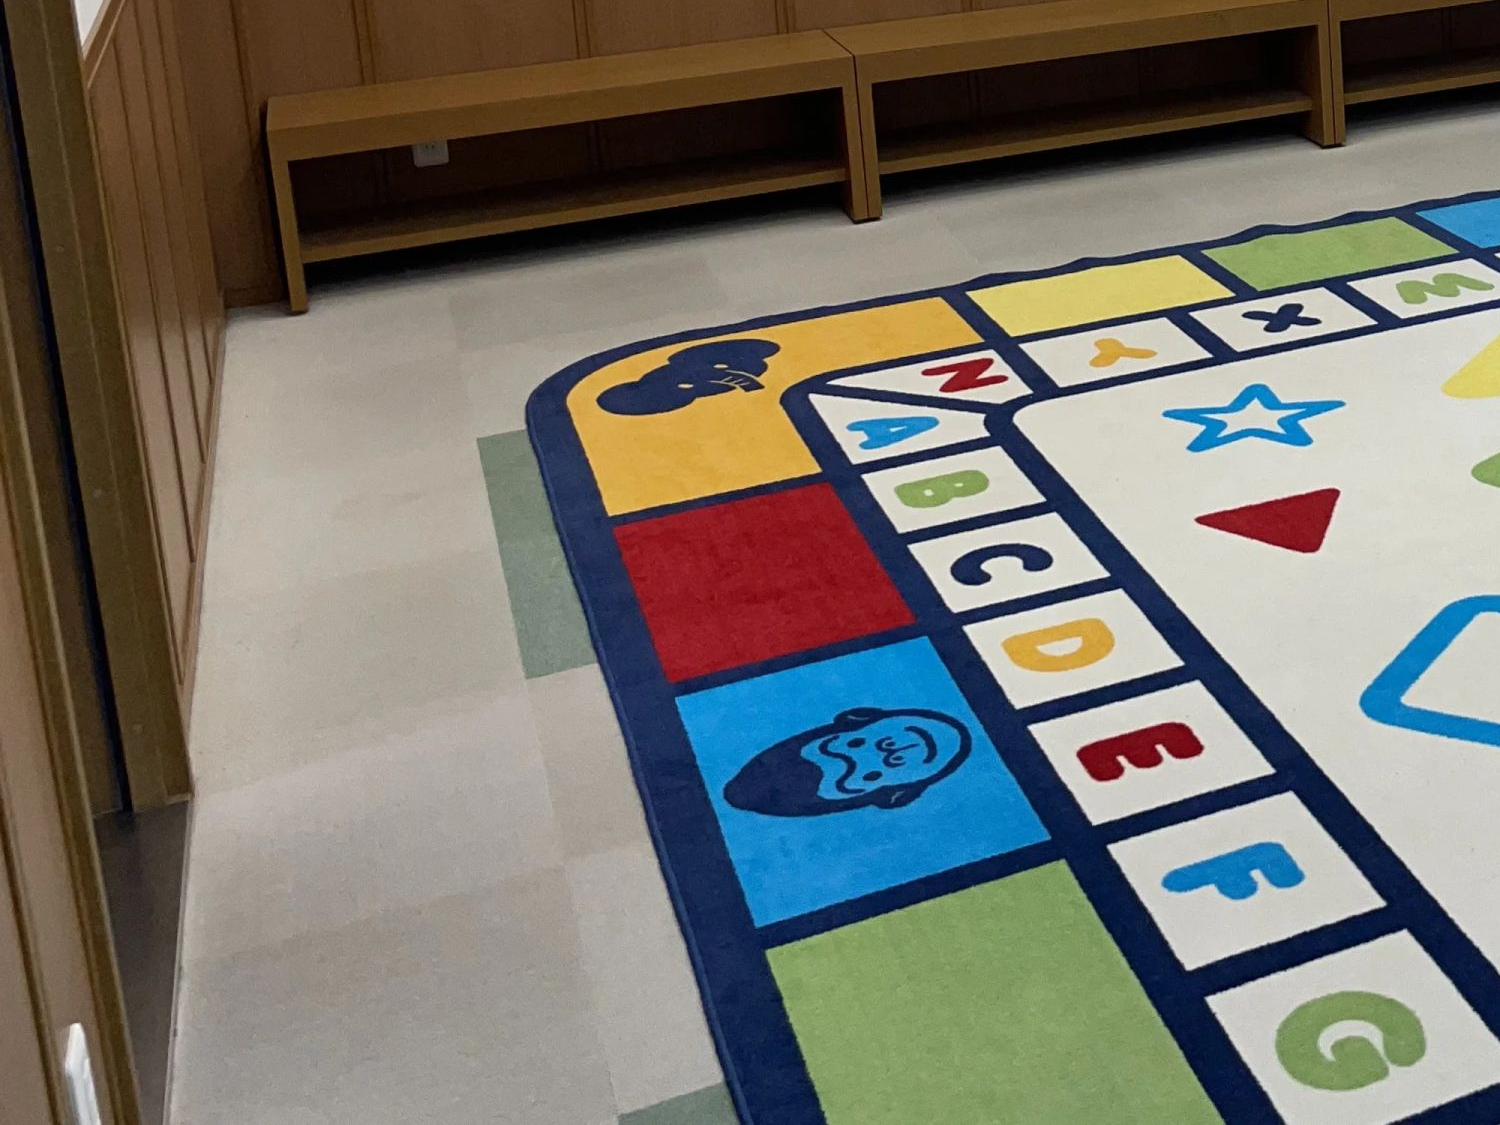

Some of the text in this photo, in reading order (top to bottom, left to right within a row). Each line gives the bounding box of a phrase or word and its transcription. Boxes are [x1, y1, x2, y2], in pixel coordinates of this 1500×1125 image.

[1395, 272, 1494, 306] W
[1241, 303, 1322, 333] X
[1087, 336, 1158, 370] Y
[847, 415, 1426, 1091] A B C D E F G
